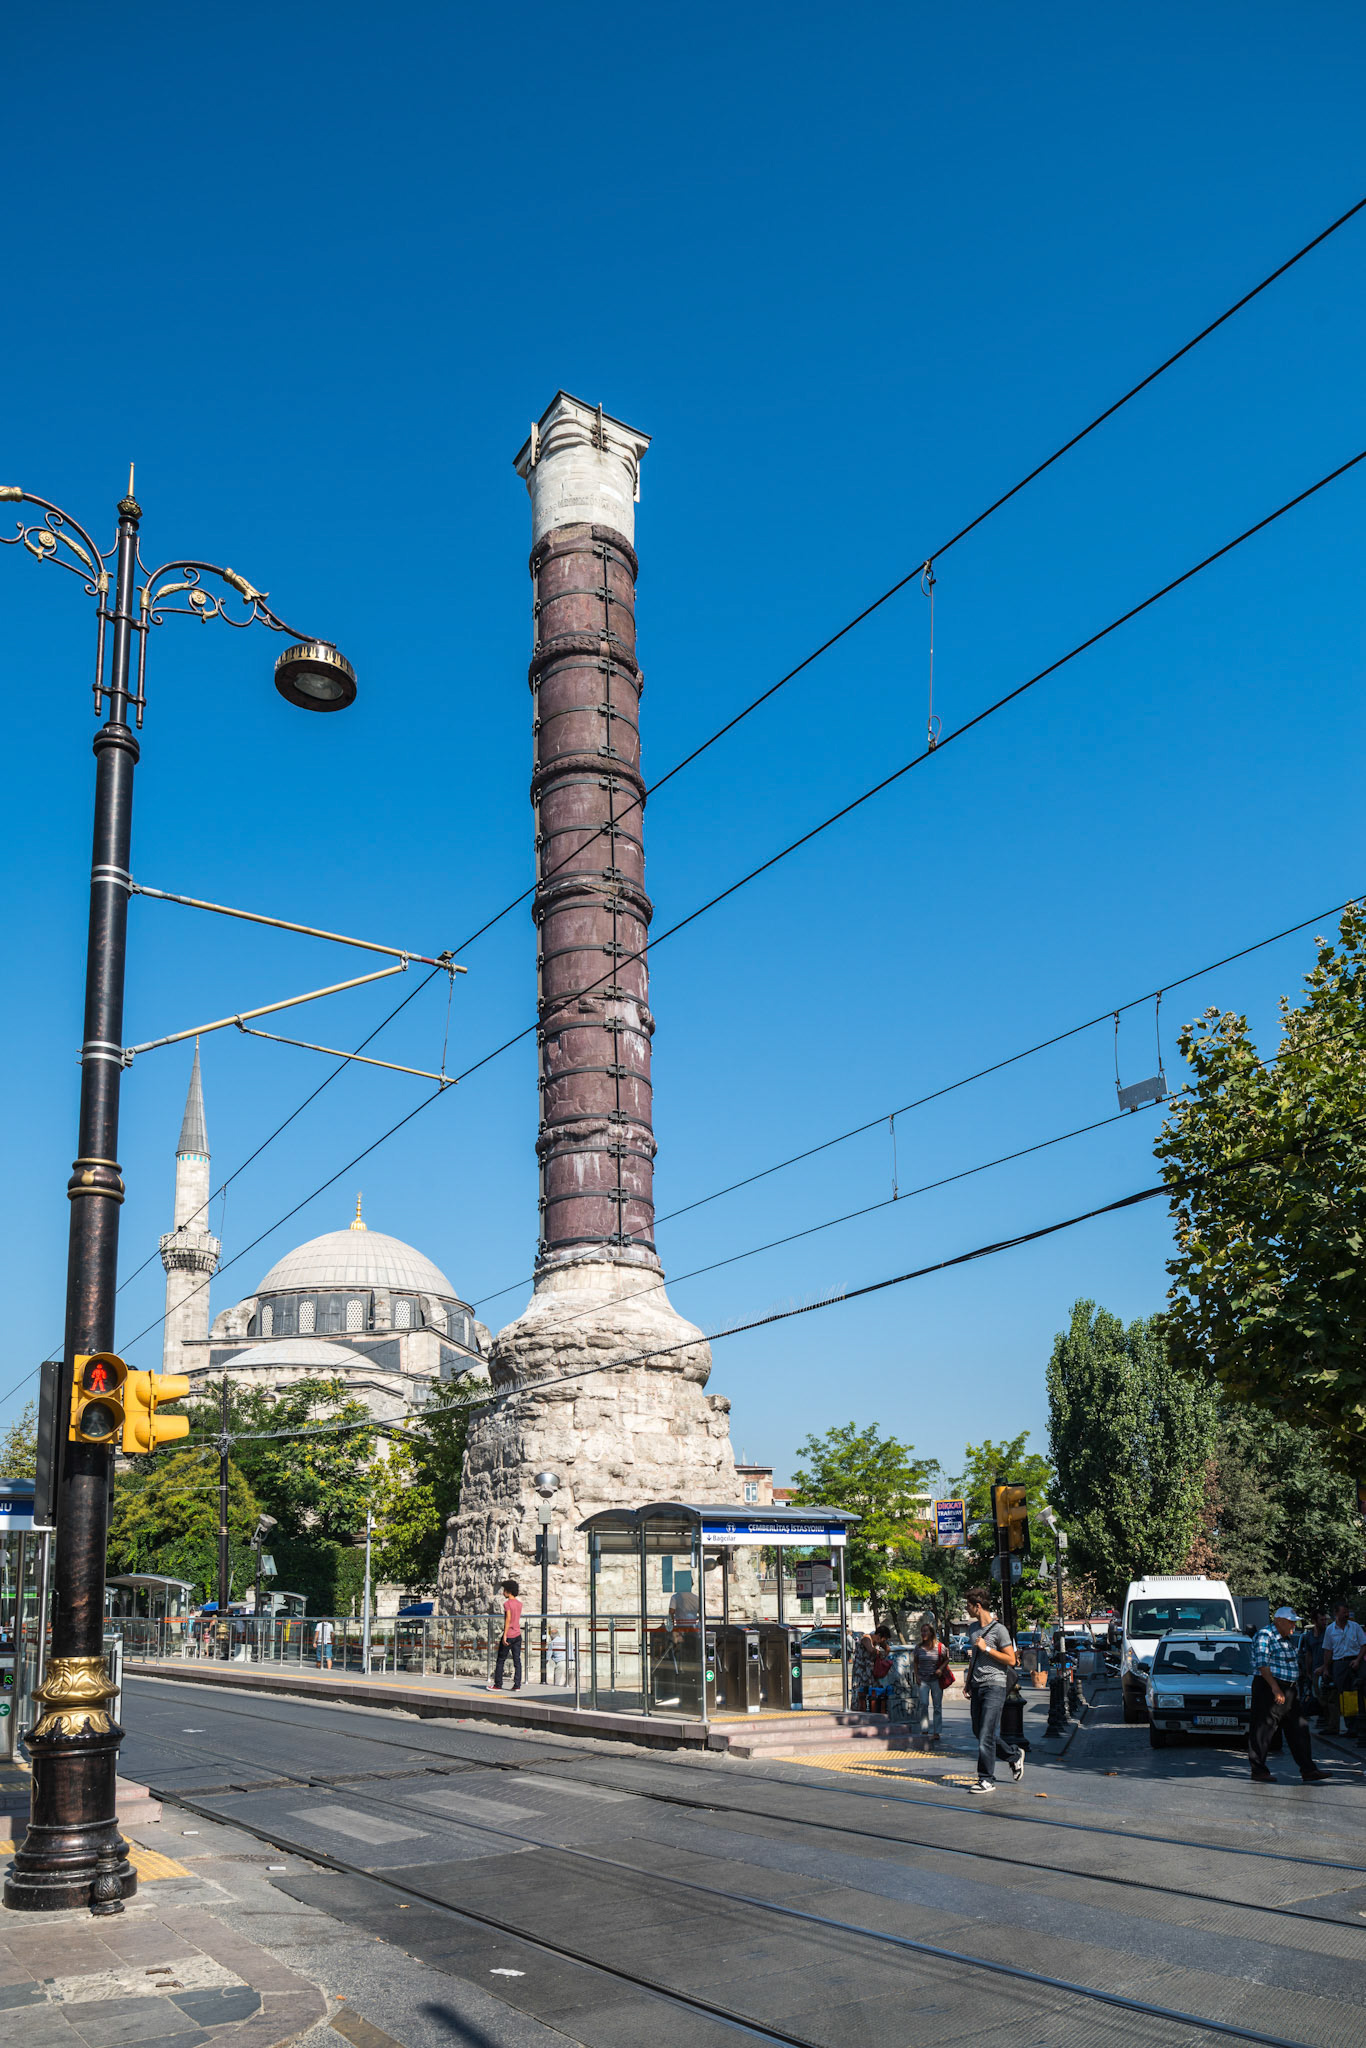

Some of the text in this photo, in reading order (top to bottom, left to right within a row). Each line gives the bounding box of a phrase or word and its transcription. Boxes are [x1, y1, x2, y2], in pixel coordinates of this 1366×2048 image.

[938, 1502, 962, 1510] DİKKAT
[748, 1524, 790, 1534] ÇEMBERLİTAŞ
[790, 1524, 825, 1532] İSTASYONU
